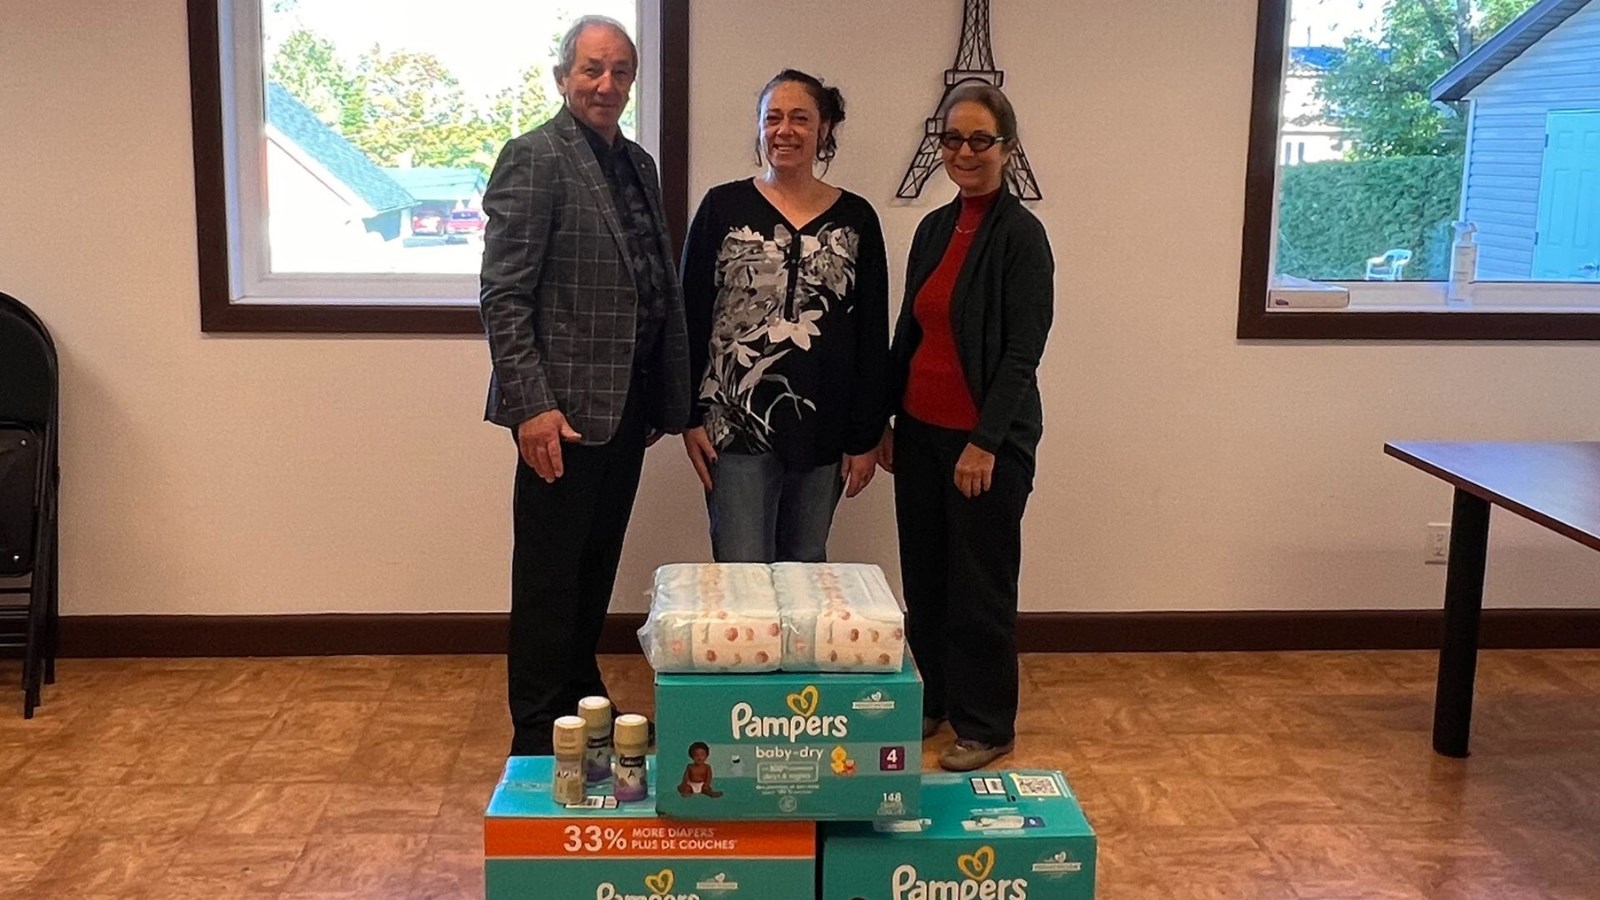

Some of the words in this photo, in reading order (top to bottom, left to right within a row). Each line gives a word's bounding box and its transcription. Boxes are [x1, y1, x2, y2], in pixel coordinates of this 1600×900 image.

[731, 702, 848, 743] Pampers
[755, 745, 824, 761] baby-dry
[886, 749, 898, 763] 4
[563, 825, 627, 852] 33%
[632, 827, 665, 838] MORE
[631, 839, 658, 850] PLUS
[661, 839, 676, 850] DE
[892, 864, 1028, 900] Pampers
